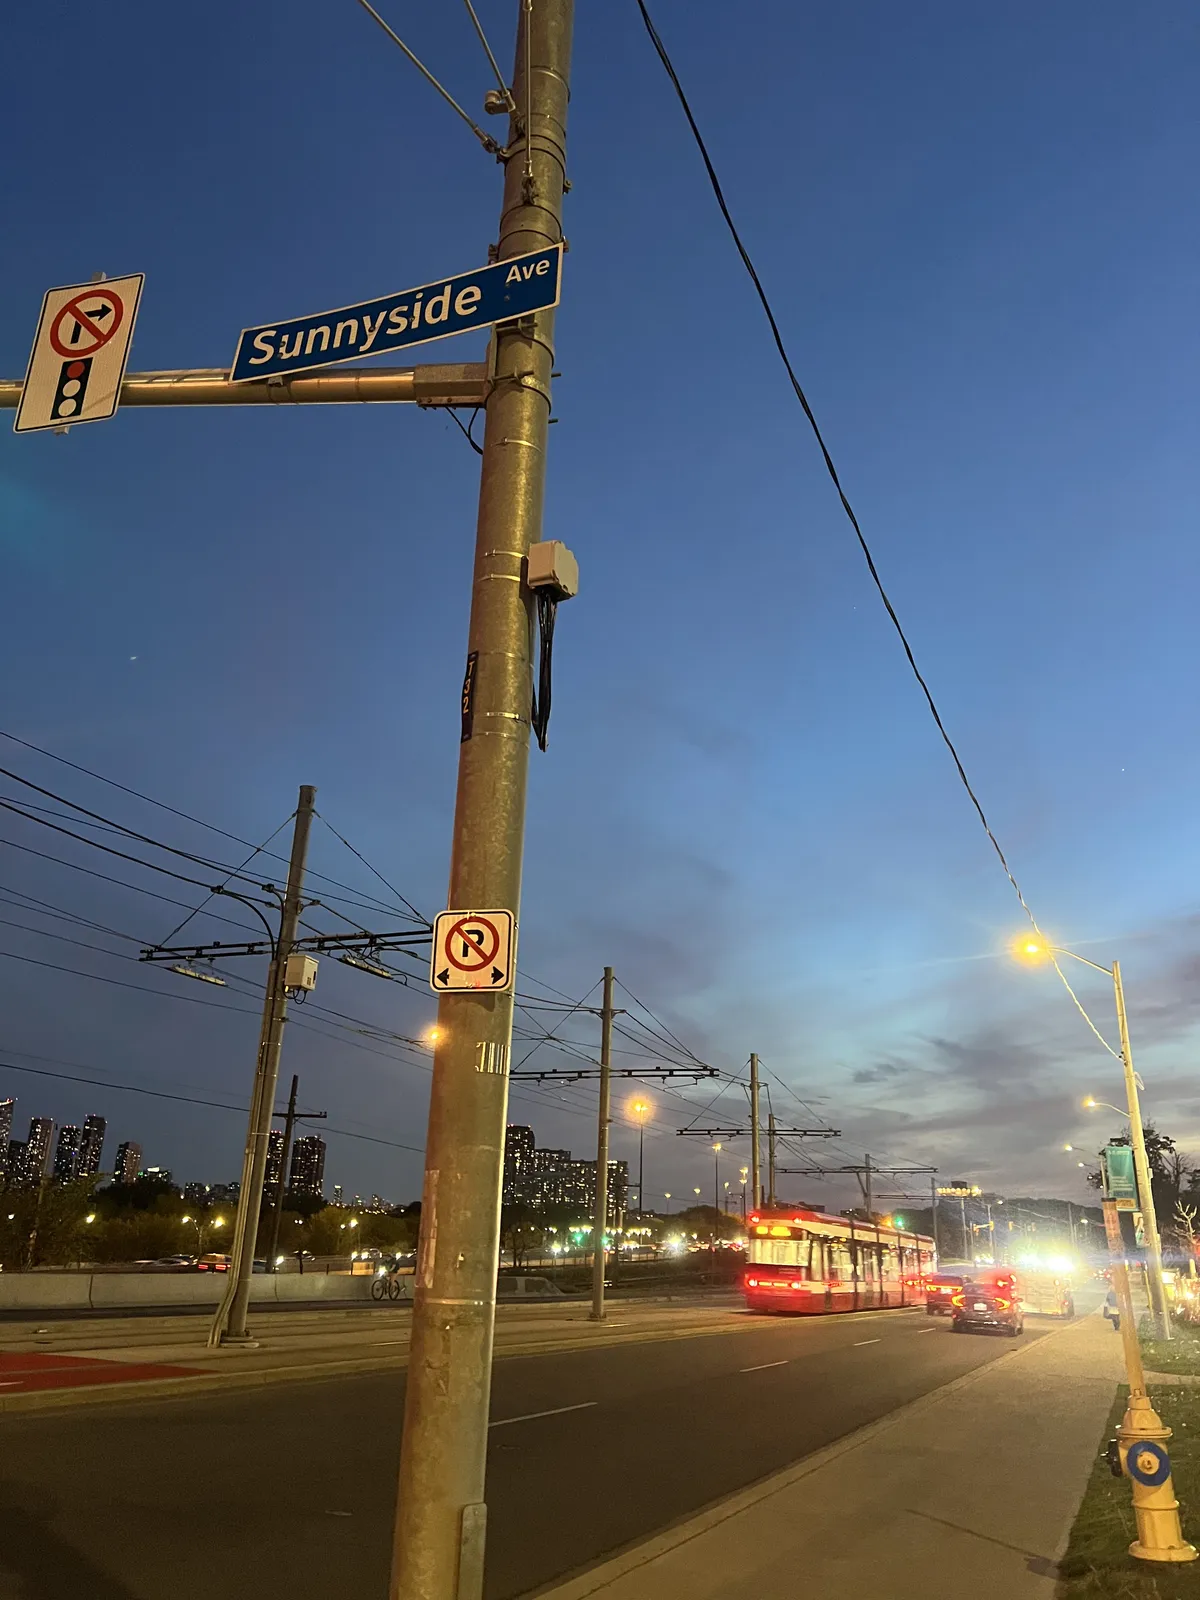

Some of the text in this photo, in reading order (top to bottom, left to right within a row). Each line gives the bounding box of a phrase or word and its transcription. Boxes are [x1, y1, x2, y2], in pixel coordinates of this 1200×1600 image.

[248, 259, 550, 365] Sunnyside Ave
[463, 661, 475, 713] T32
[461, 929, 485, 958] P
